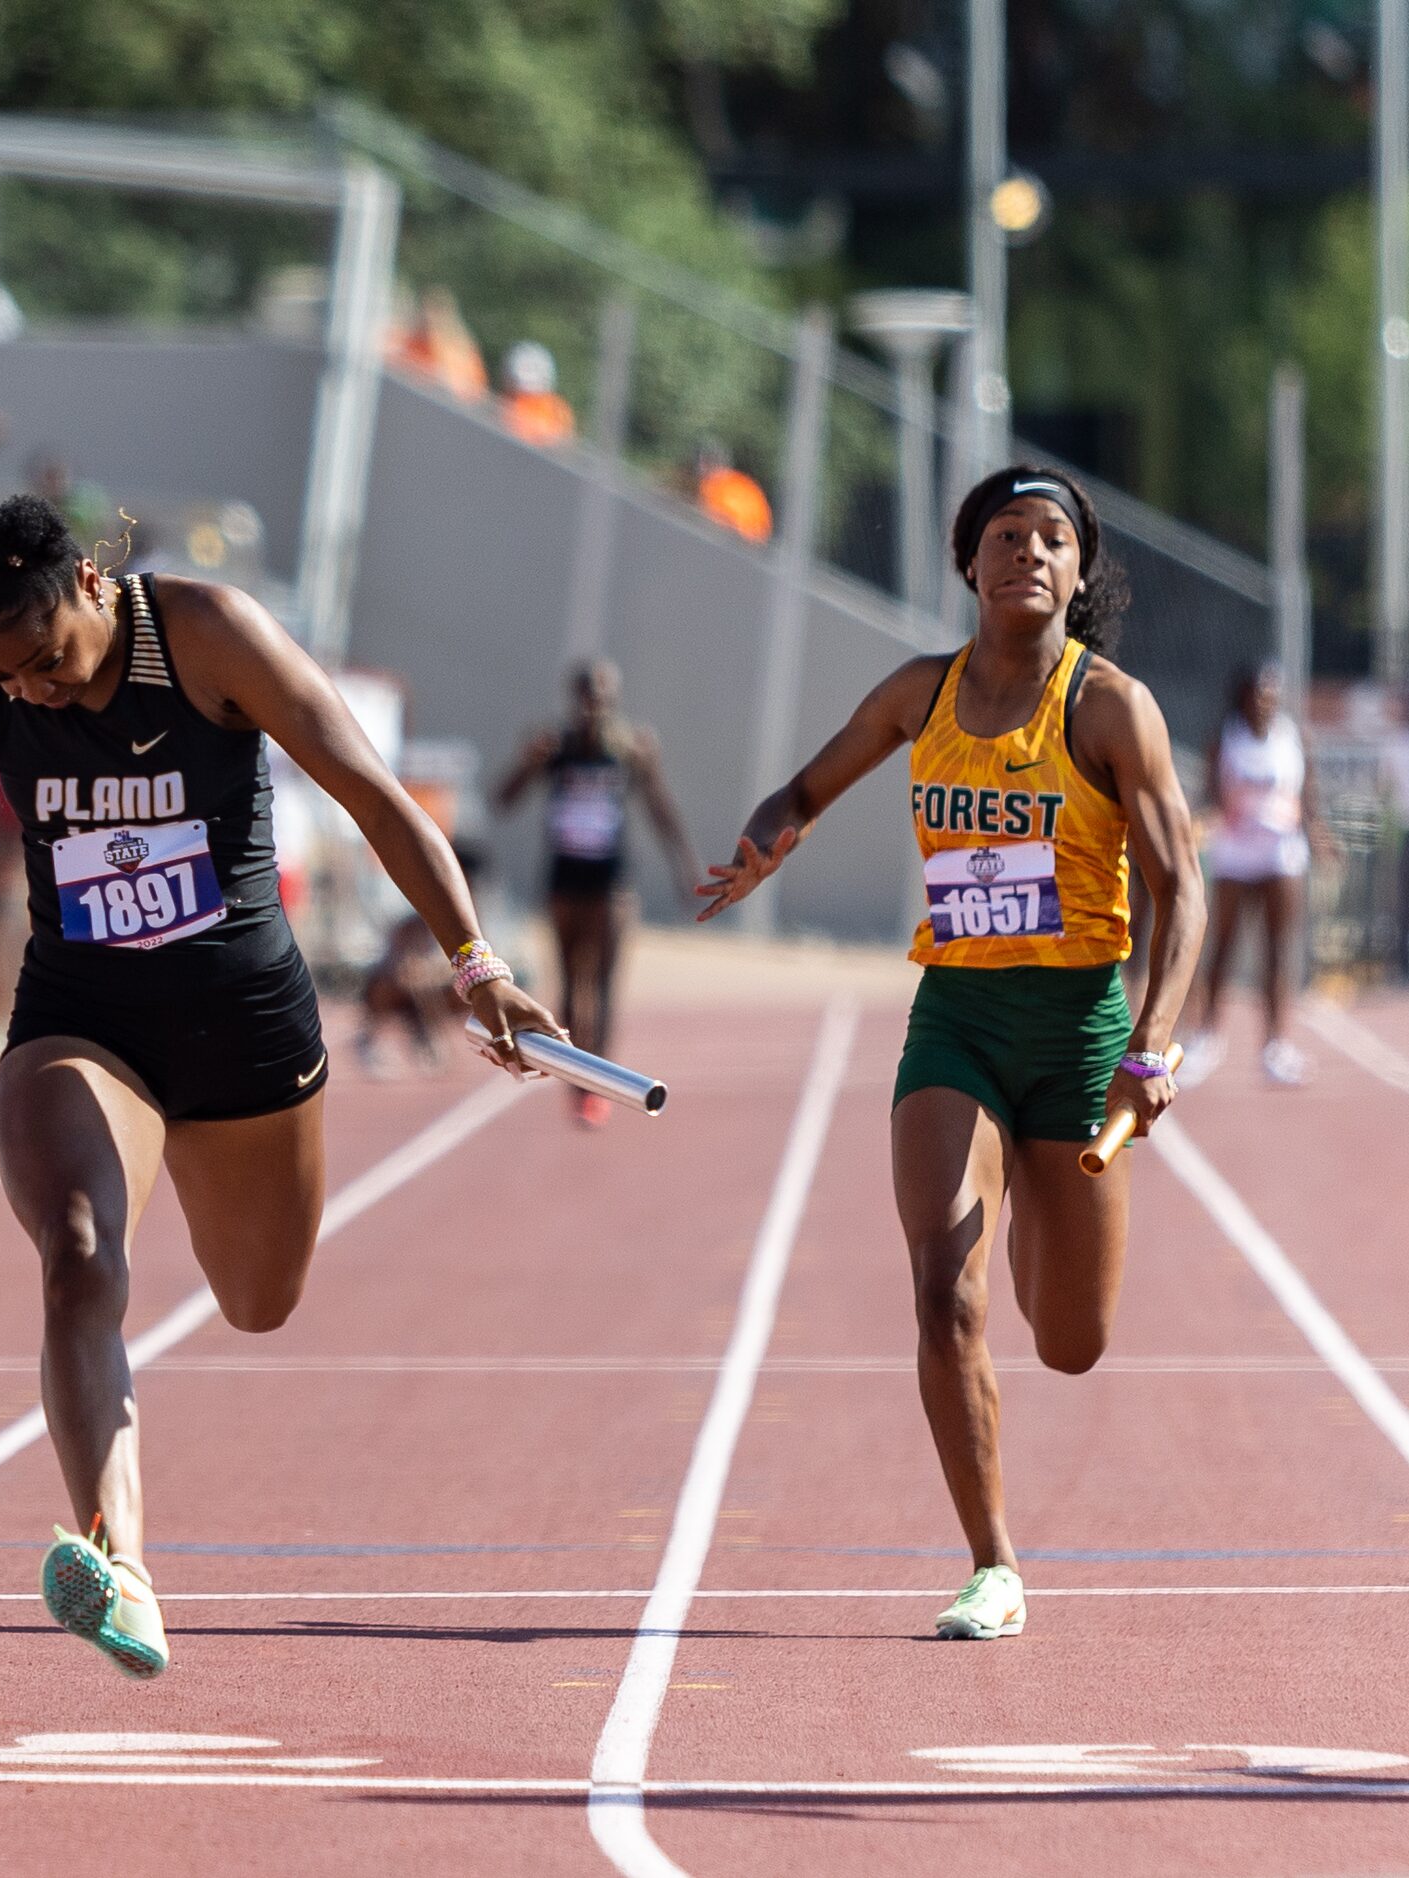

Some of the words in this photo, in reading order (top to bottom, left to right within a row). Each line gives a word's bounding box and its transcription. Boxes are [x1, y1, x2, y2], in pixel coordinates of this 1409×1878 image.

[35, 771, 186, 822] PLANO
[912, 784, 1066, 839] FOREST
[105, 844, 148, 862] STATE
[79, 862, 199, 940] 1897
[943, 883, 1041, 938] 1657
[137, 936, 164, 950] 2022
